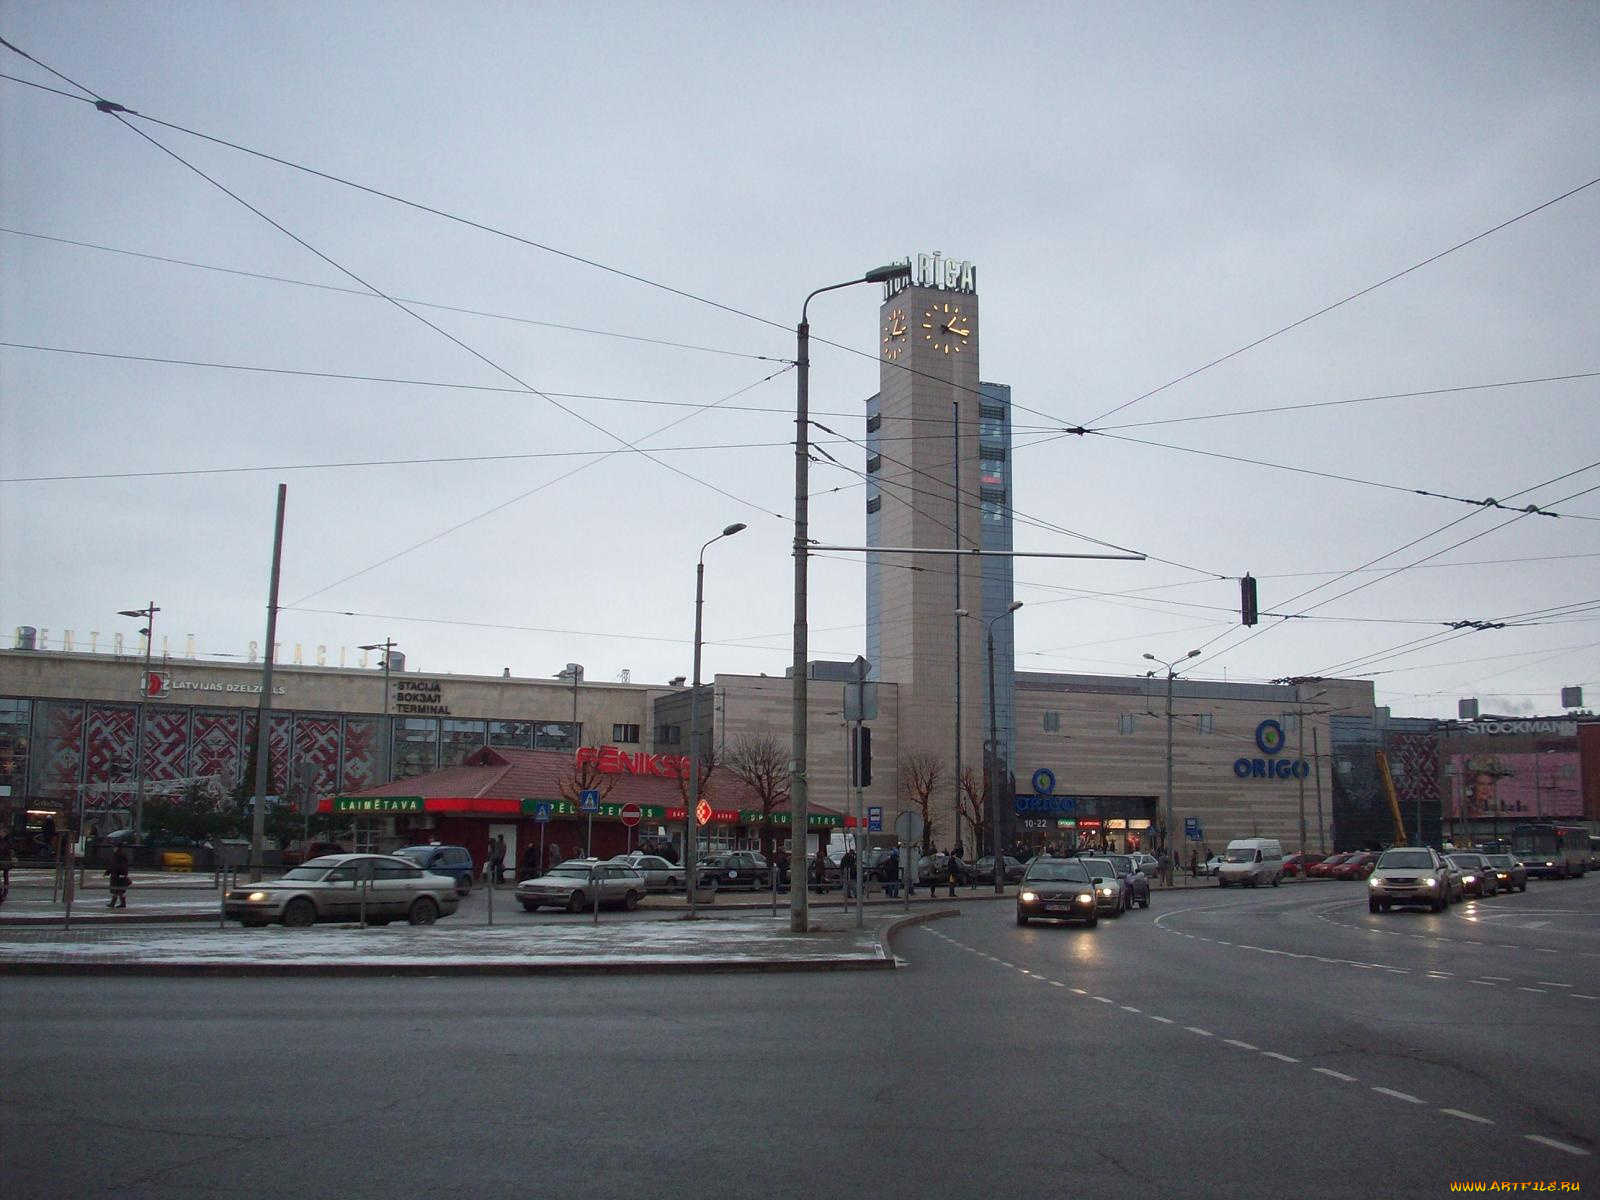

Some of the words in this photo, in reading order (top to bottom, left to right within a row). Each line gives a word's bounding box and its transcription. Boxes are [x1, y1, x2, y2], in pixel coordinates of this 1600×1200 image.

[917, 250, 976, 293] RĪGA
[172, 681, 223, 692] LATVIJAS
[398, 681, 441, 692] STACIJA
[397, 692, 441, 703] ВОКЗАЛ
[396, 703, 451, 714] TERMINAL
[1466, 720, 1578, 736] STOCKMANN
[1234, 757, 1310, 779] ORIGO
[341, 799, 417, 811] LAIMĒTAVA
[1024, 819, 1047, 828] 10-22
